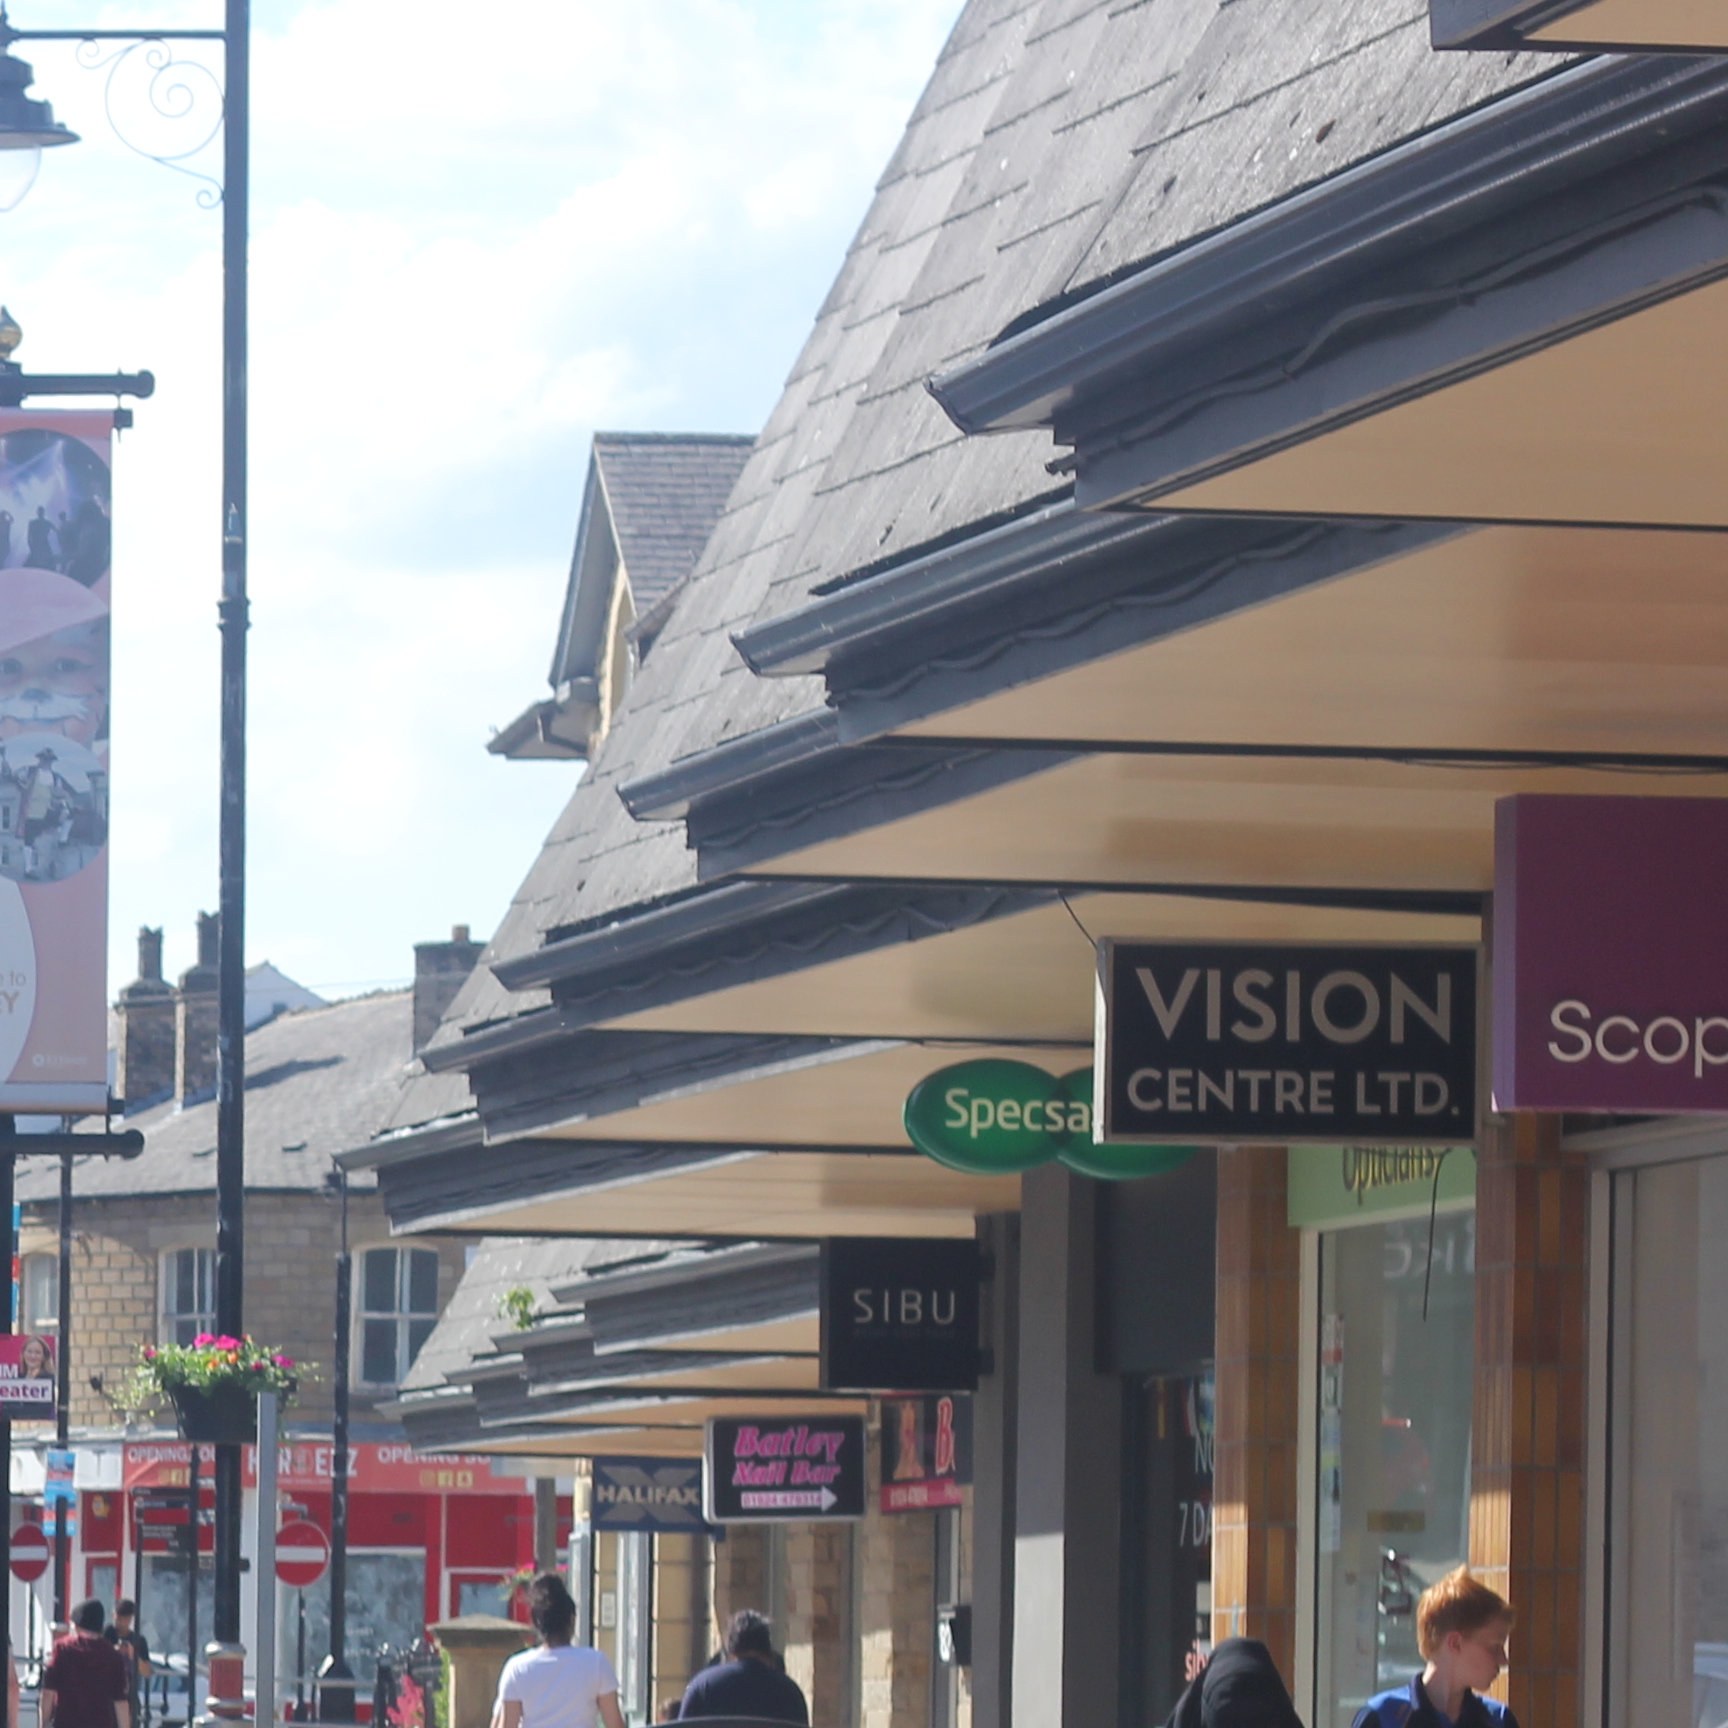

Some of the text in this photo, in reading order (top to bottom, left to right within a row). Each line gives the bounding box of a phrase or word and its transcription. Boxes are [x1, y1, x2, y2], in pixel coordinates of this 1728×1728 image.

[10, 970, 26, 987] to
[1136, 968, 1451, 1045] VISION
[1127, 1068, 1460, 1116] CENTRE LTD.
[854, 1288, 956, 1324] SIBU
[734, 1425, 845, 1463] Batley
[732, 1460, 841, 1486] Nail Bar
[597, 1485, 700, 1506] HALIFAX
